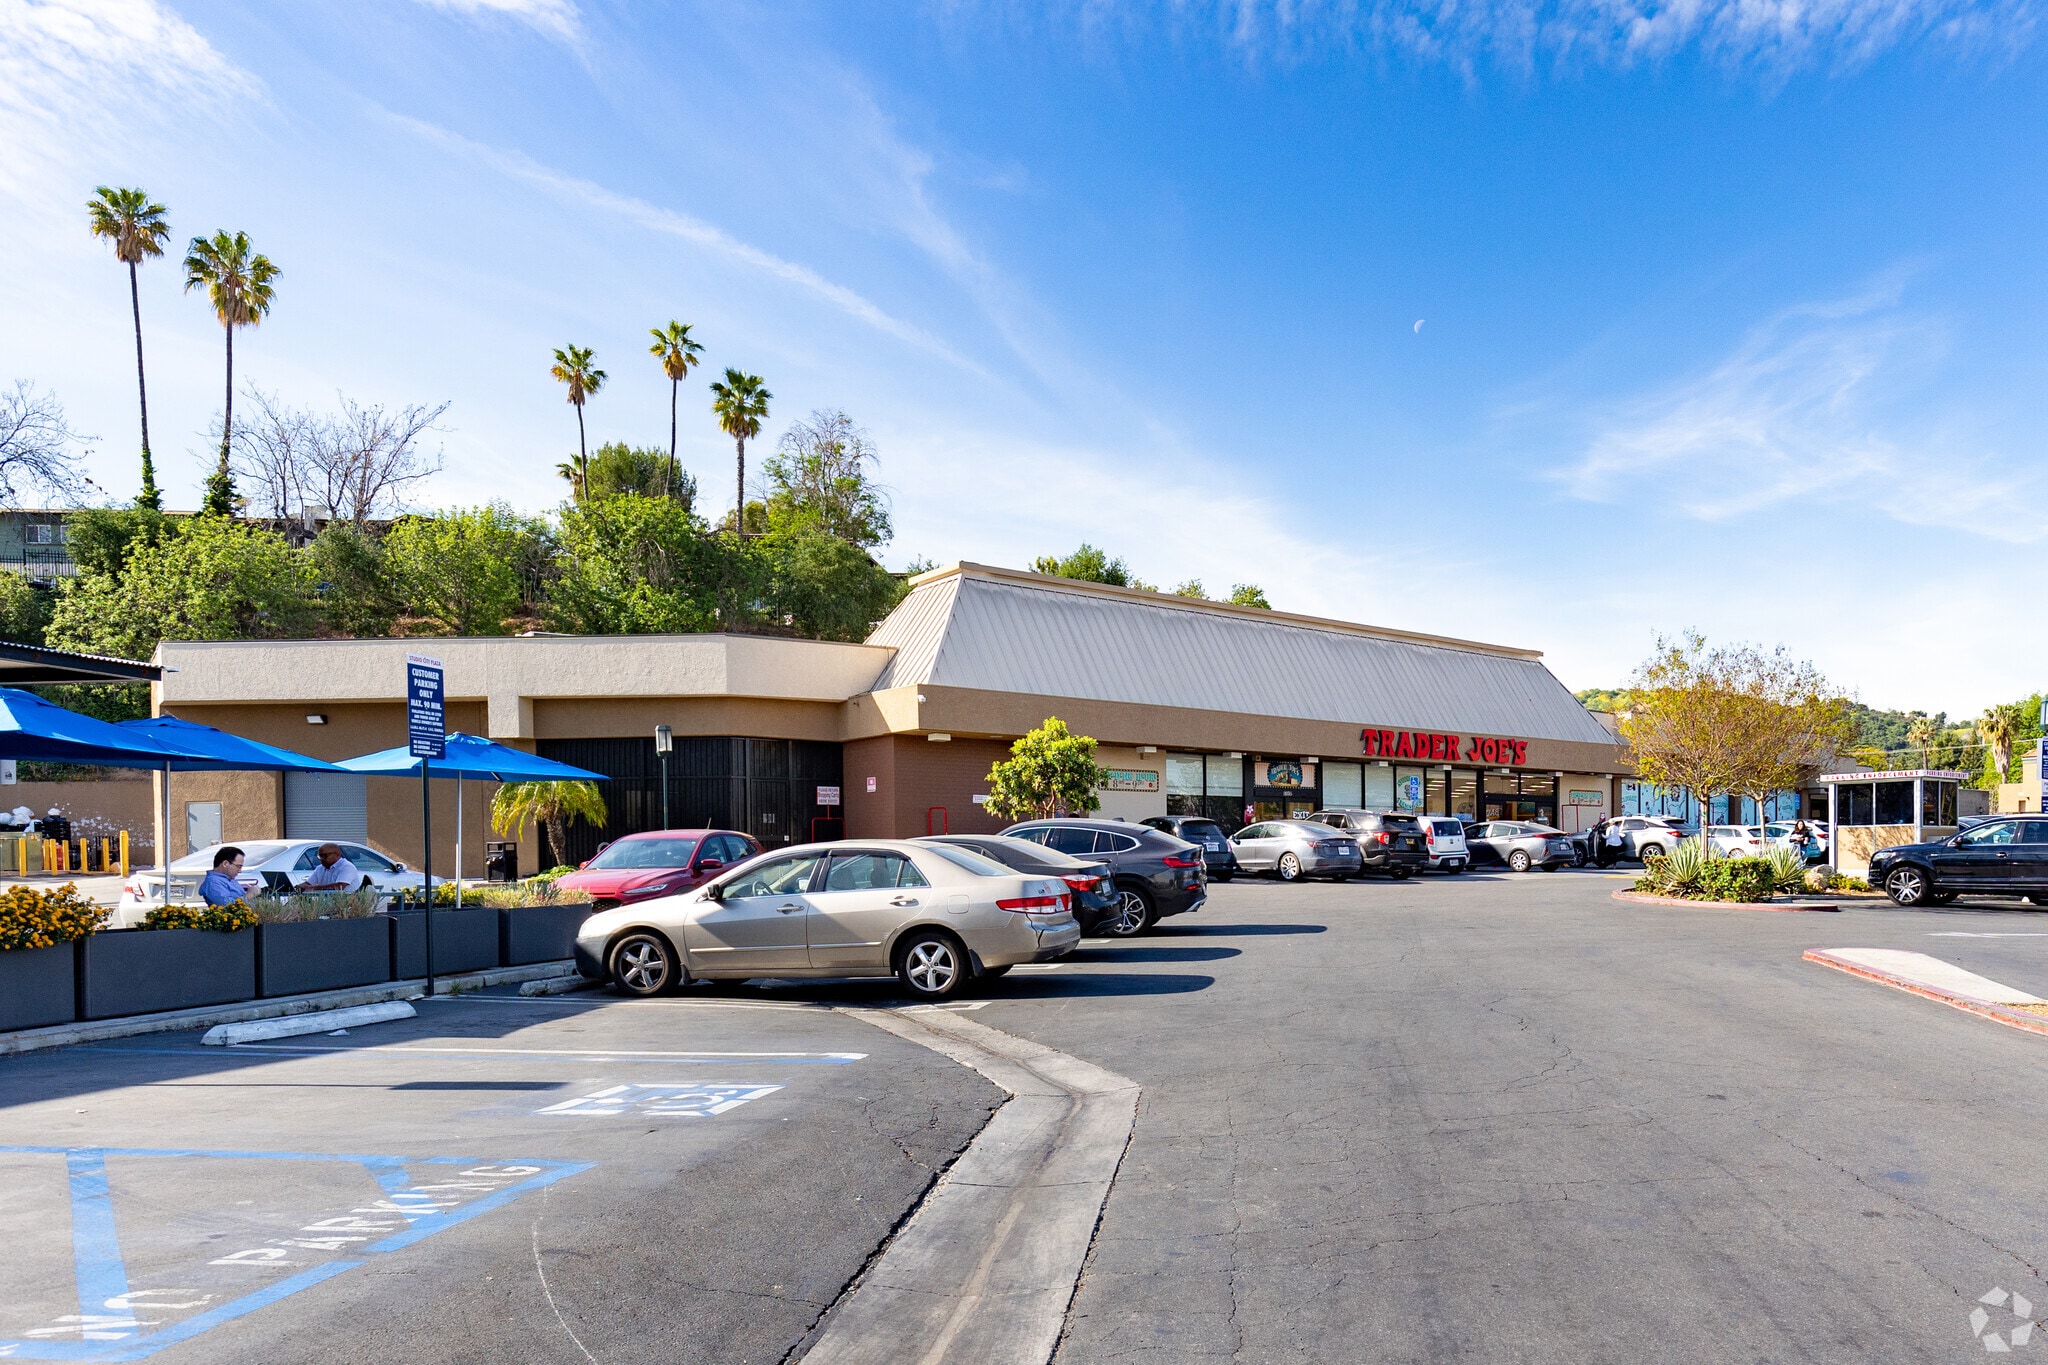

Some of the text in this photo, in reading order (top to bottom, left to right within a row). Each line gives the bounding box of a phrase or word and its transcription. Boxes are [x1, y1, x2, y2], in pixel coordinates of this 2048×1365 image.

[412, 668, 439, 680] CUSTOMER
[414, 678, 438, 689] PARKING
[419, 689, 433, 698] ONLY
[411, 698, 423, 707] MAX.
[424, 700, 430, 708] 90
[1360, 729, 1528, 765] TRADER JOE'S
[1863, 770, 1919, 779] ENFORCEMENT
[1293, 810, 1310, 820] EXIT
[207, 1165, 540, 1266] PARKING
